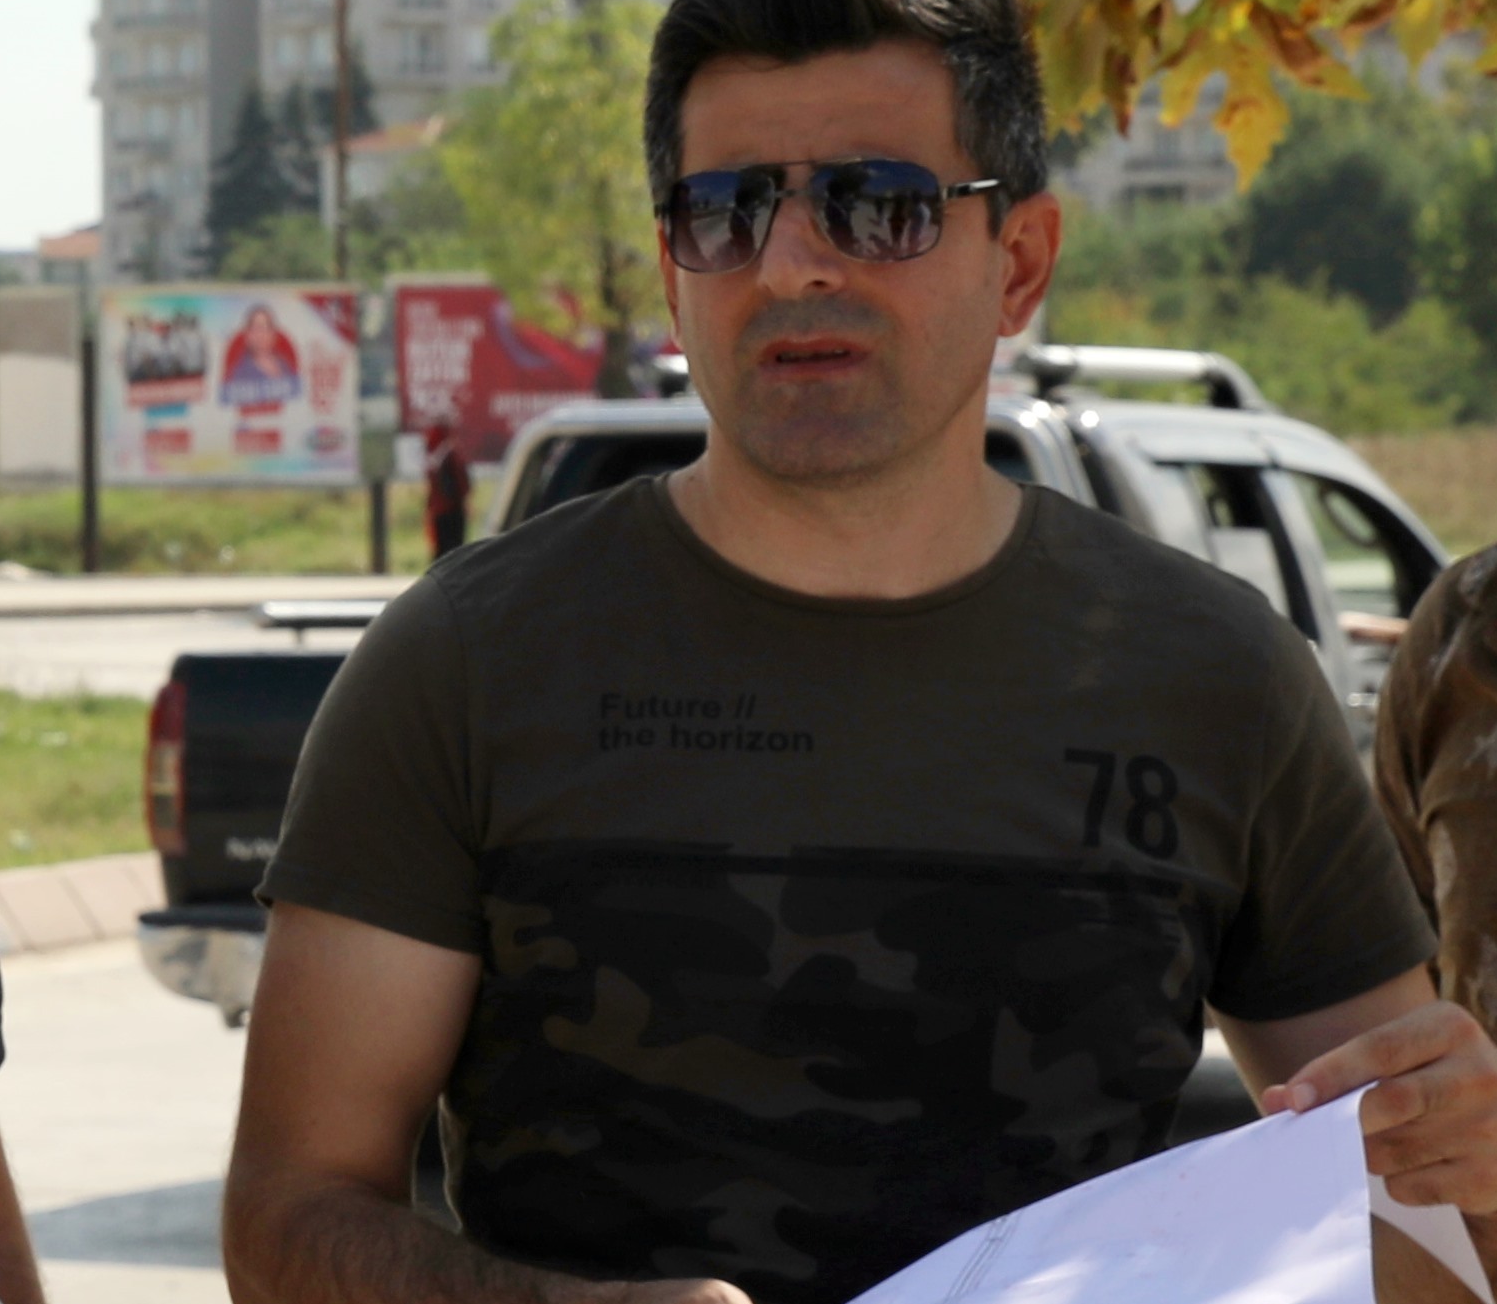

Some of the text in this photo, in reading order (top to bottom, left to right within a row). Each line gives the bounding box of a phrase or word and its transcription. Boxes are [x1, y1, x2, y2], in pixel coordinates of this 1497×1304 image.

[599, 692, 722, 720] Future
[598, 723, 815, 753] the horizon
[1064, 746, 1179, 860] 78
